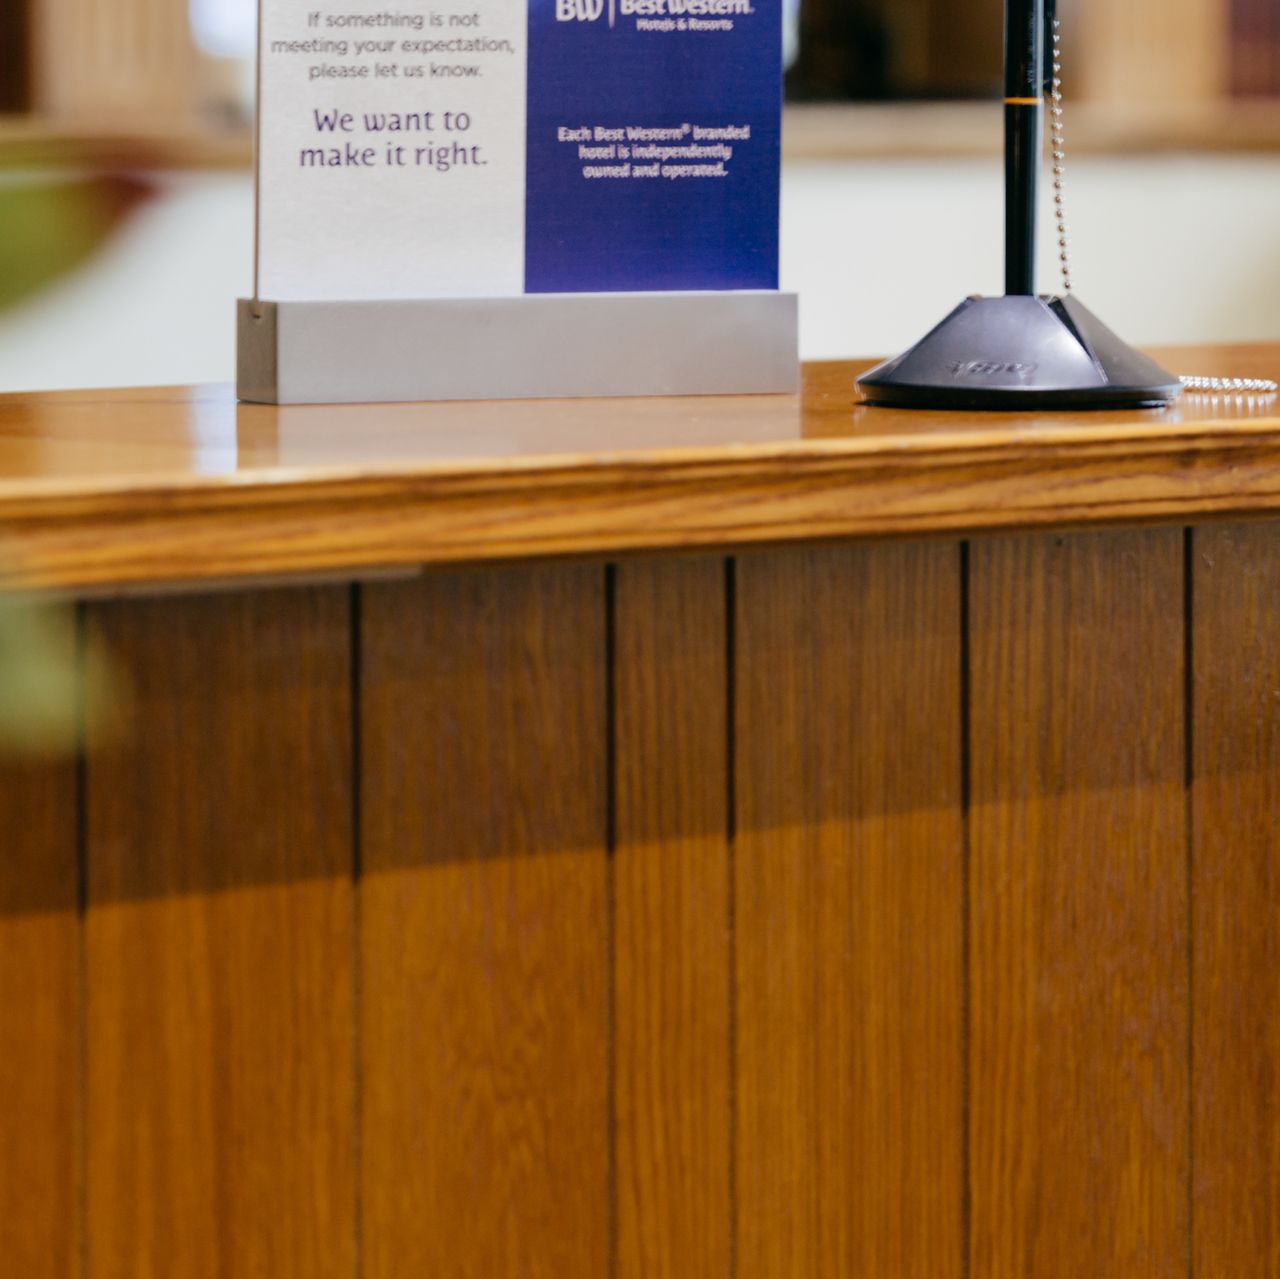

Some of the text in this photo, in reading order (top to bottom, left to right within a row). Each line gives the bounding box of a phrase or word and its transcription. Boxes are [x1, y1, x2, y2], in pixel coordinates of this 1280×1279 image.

[308, 12, 480, 30] If something is not
[677, 19, 687, 31] &
[689, 19, 734, 31] Resorts
[271, 37, 516, 55] meeting your expectation,
[308, 63, 483, 80] please let us know.
[313, 108, 471, 131] We want to
[557, 126, 592, 141] Each
[594, 126, 625, 141] Best
[693, 125, 751, 140] branded
[300, 141, 488, 171] make it right.
[578, 143, 732, 161] hotel is independently
[582, 162, 630, 178] owned
[632, 162, 660, 177] and
